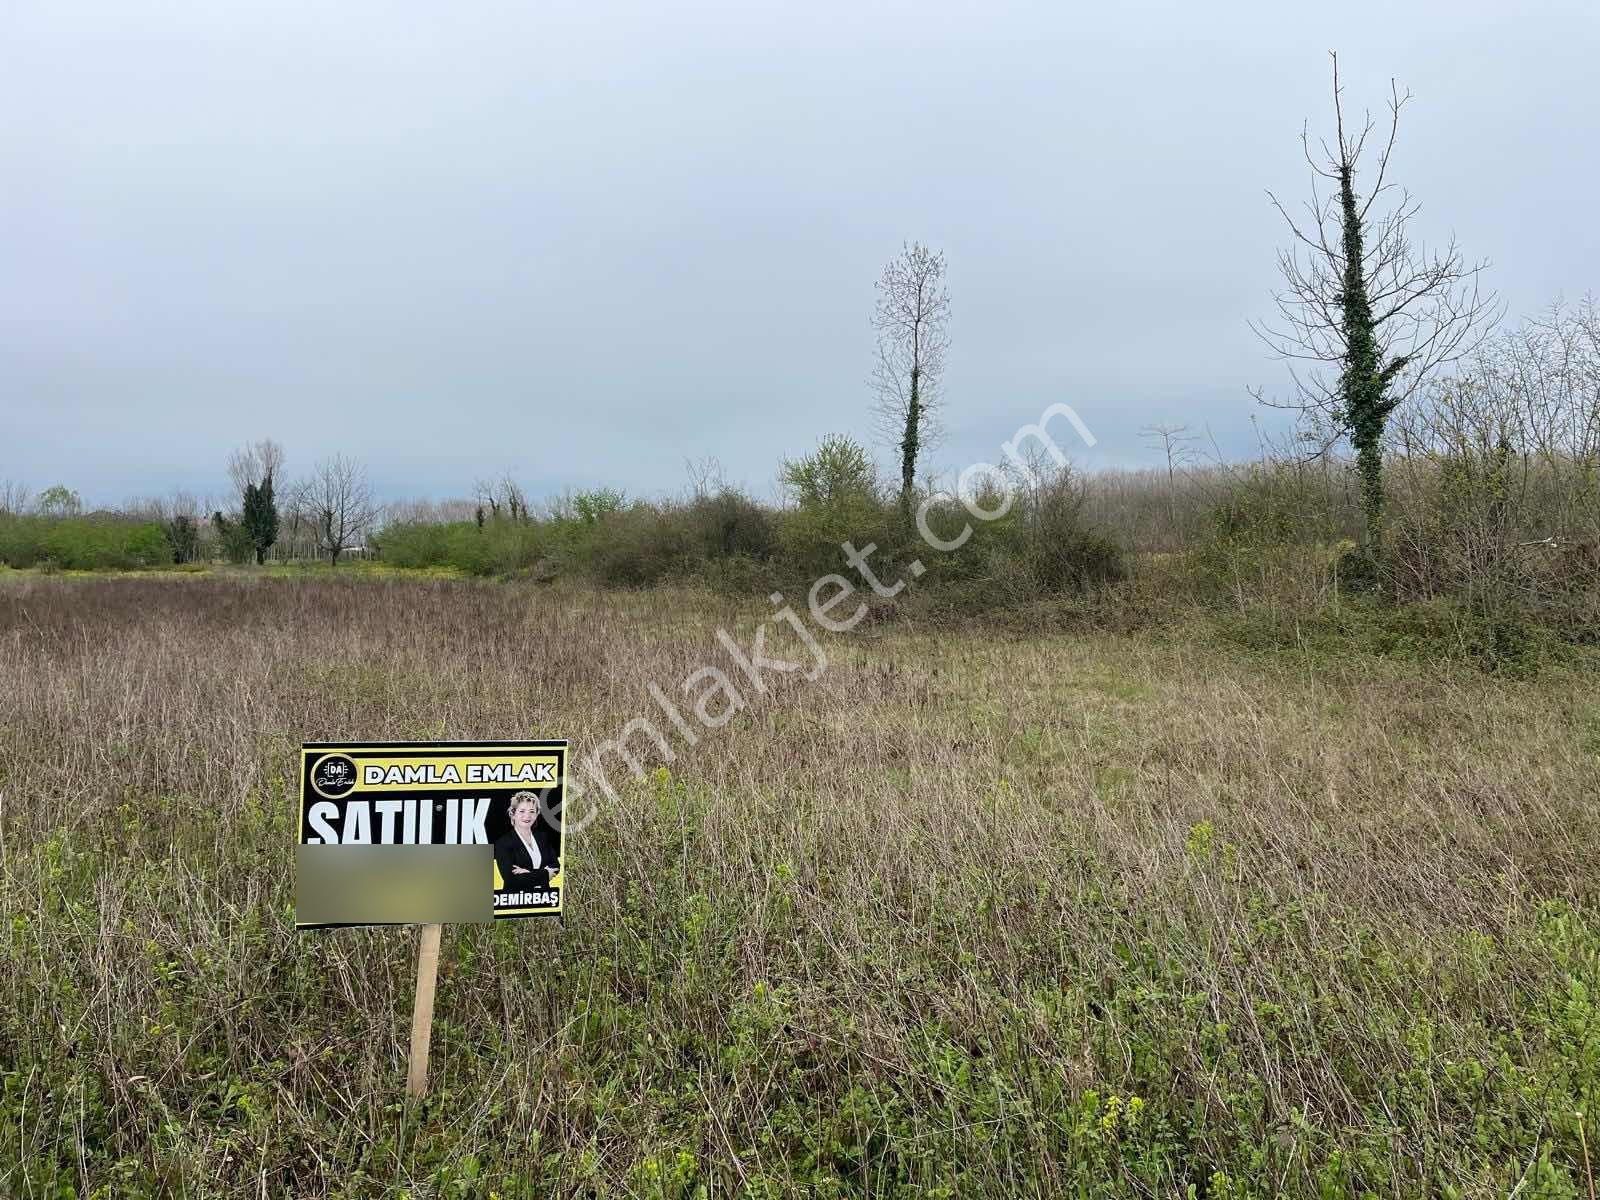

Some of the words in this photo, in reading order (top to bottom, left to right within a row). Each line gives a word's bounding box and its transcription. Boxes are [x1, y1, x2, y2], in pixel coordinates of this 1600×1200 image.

[330, 765, 342, 774] DA
[364, 765, 461, 785] DAMLA
[466, 763, 555, 782] EMLAK
